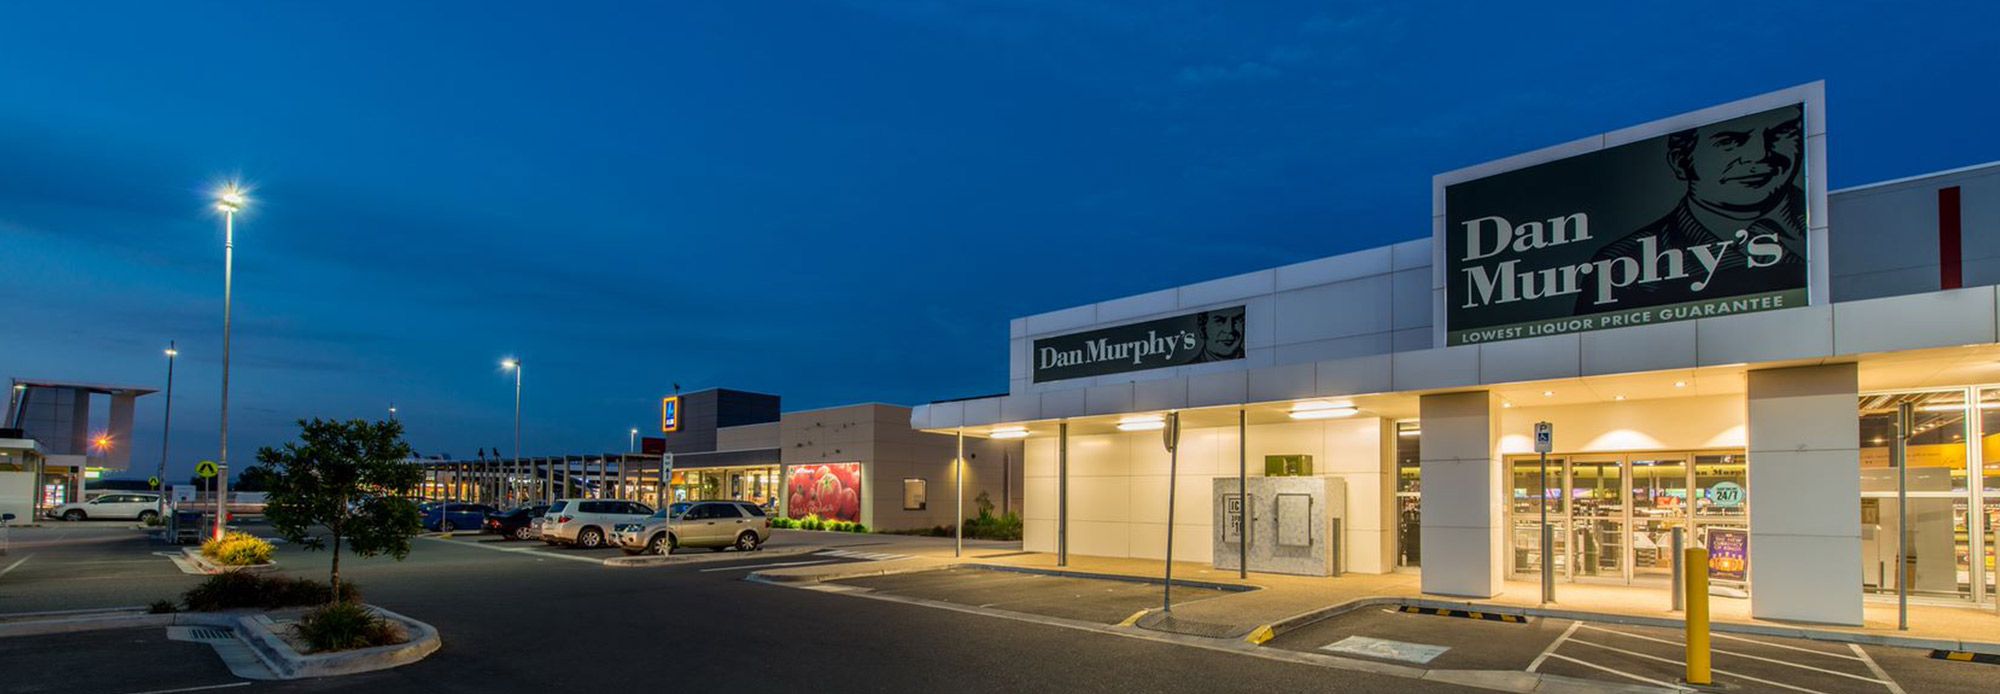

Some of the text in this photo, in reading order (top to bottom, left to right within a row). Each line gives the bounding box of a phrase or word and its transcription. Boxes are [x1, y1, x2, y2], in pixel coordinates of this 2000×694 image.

[1461, 212, 1593, 262] Dan
[1461, 229, 1783, 308] Murphy's
[1462, 295, 1783, 343] LOWEST LIQUOR PRICE GUARANTEE
[1039, 330, 1196, 370] Dan Murphy's
[1716, 491, 1738, 501] 24/7
